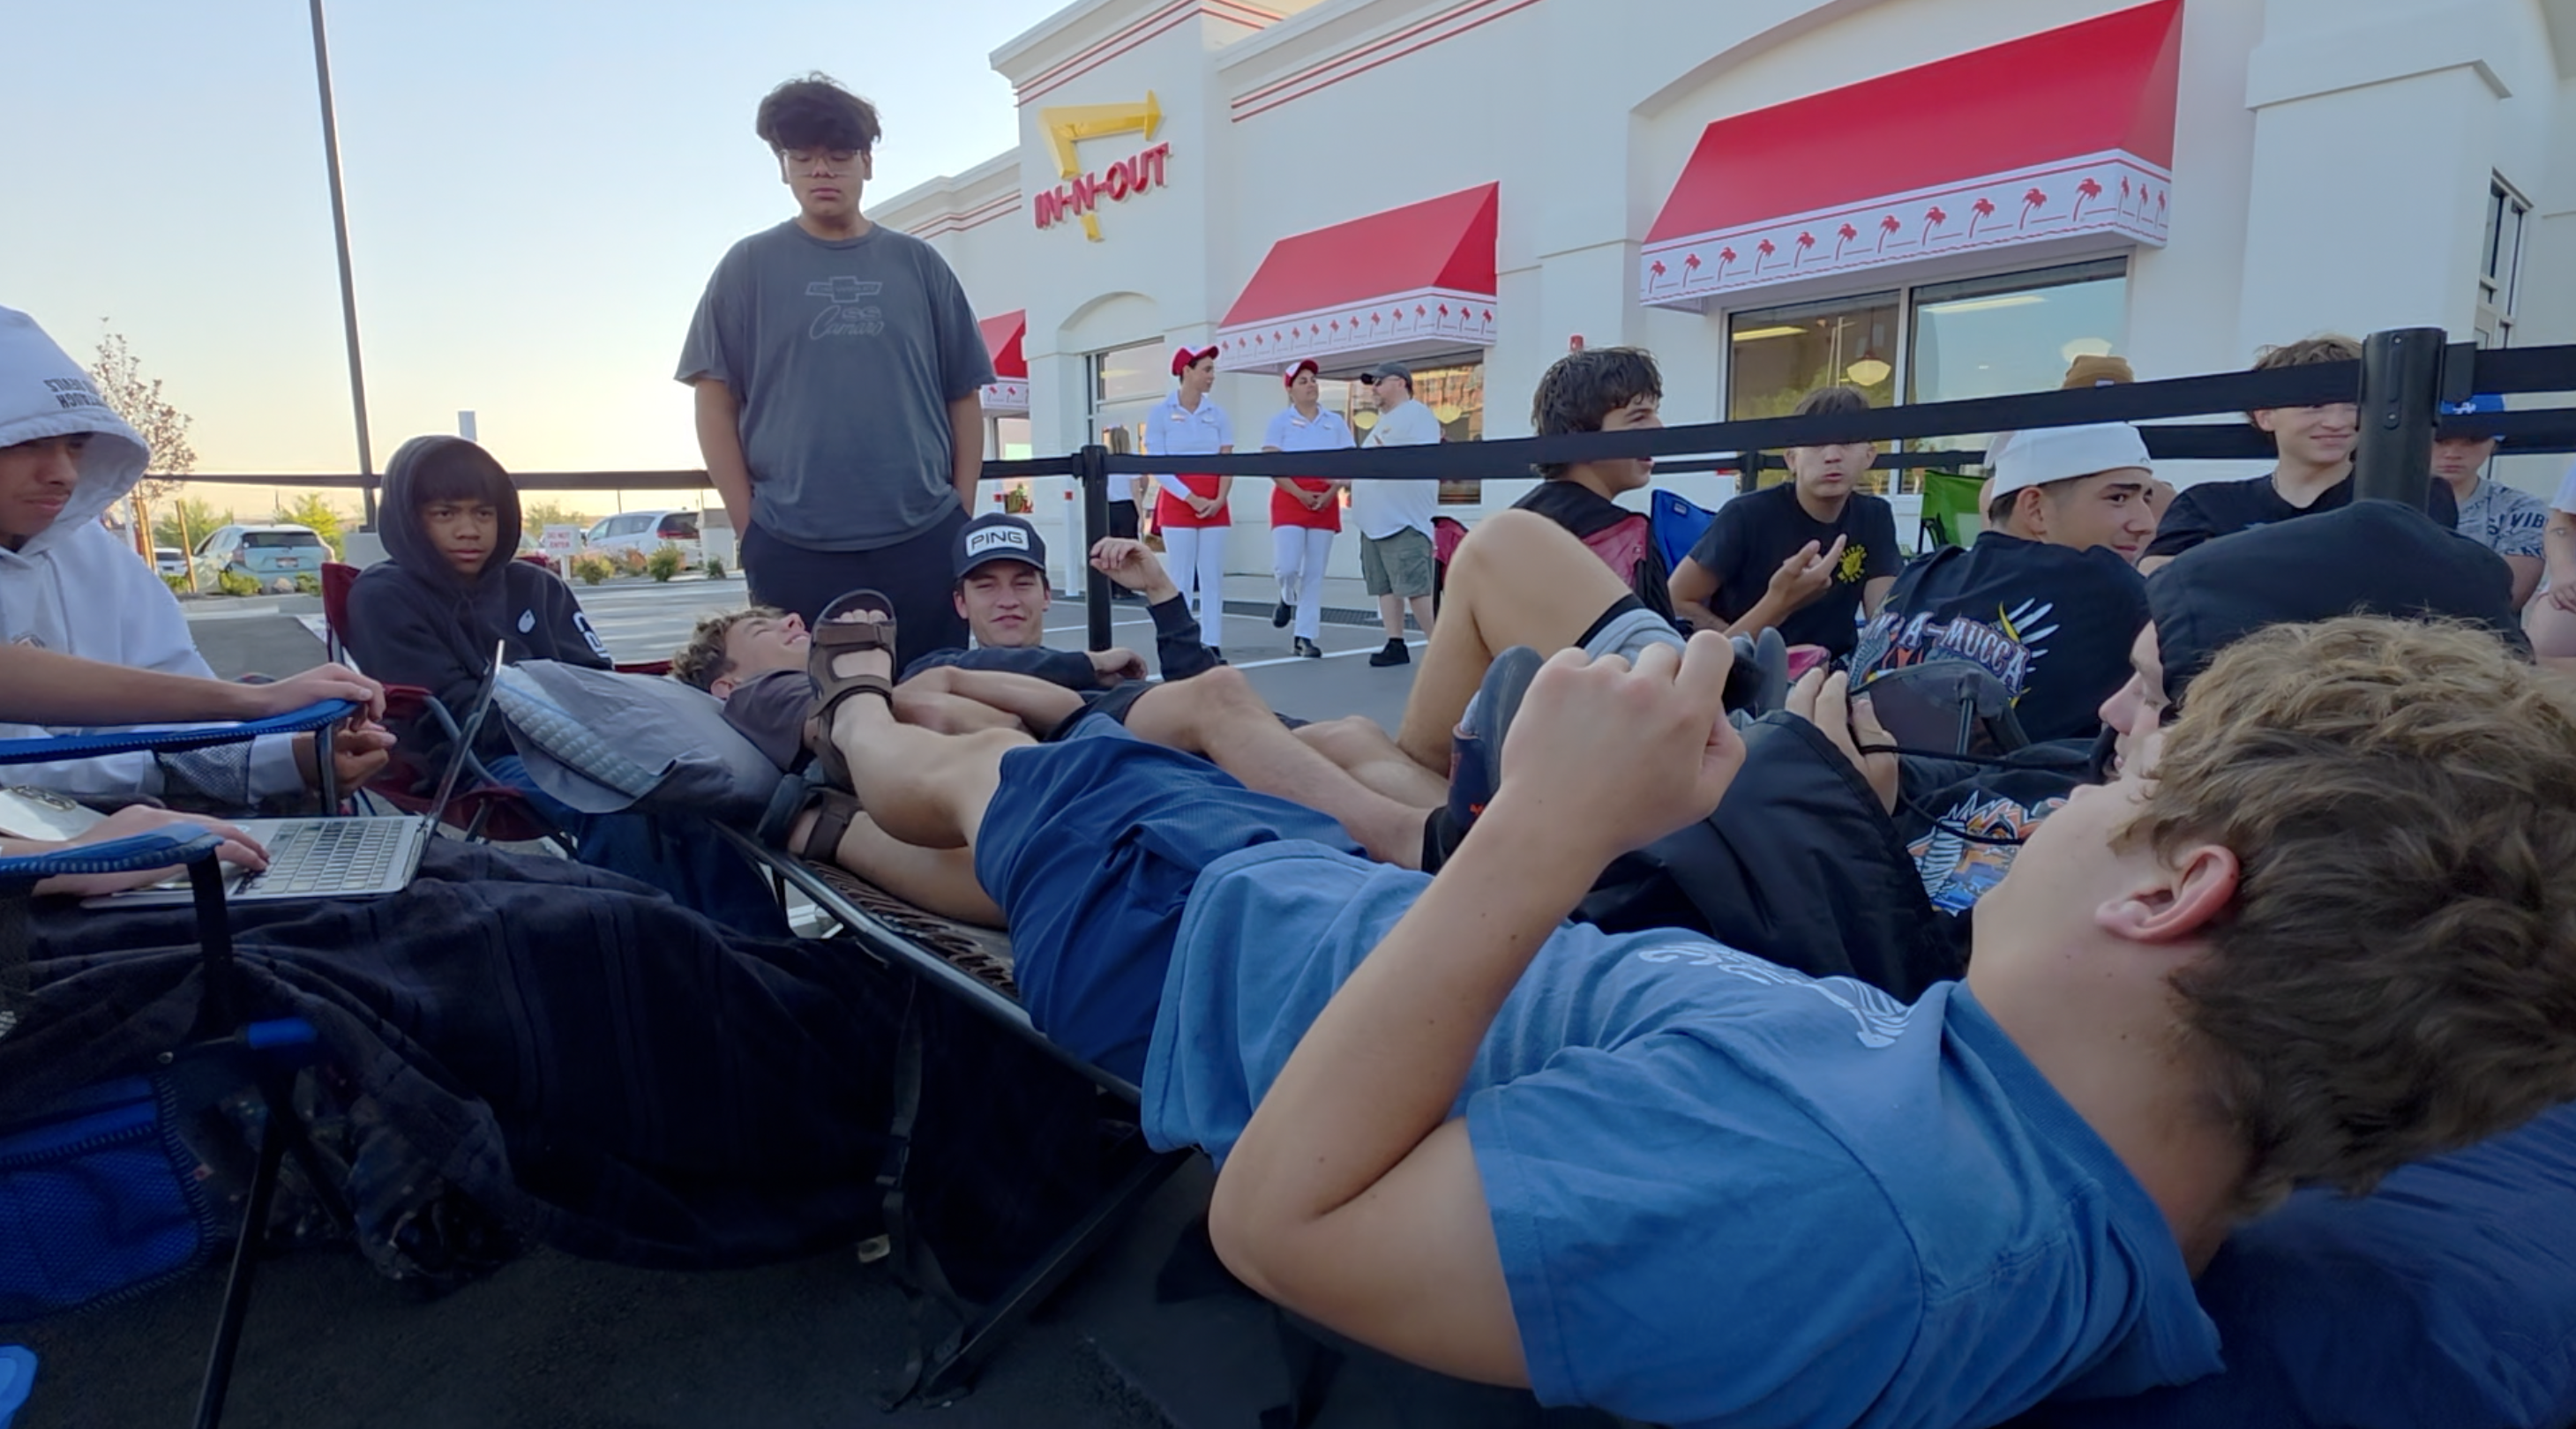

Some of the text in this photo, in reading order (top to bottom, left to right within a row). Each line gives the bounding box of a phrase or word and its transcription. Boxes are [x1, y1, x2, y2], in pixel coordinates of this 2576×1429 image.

[1035, 142, 1169, 229] IN-N-OUT
[2510, 512, 2549, 529] VIB
[970, 531, 1023, 550] PING
